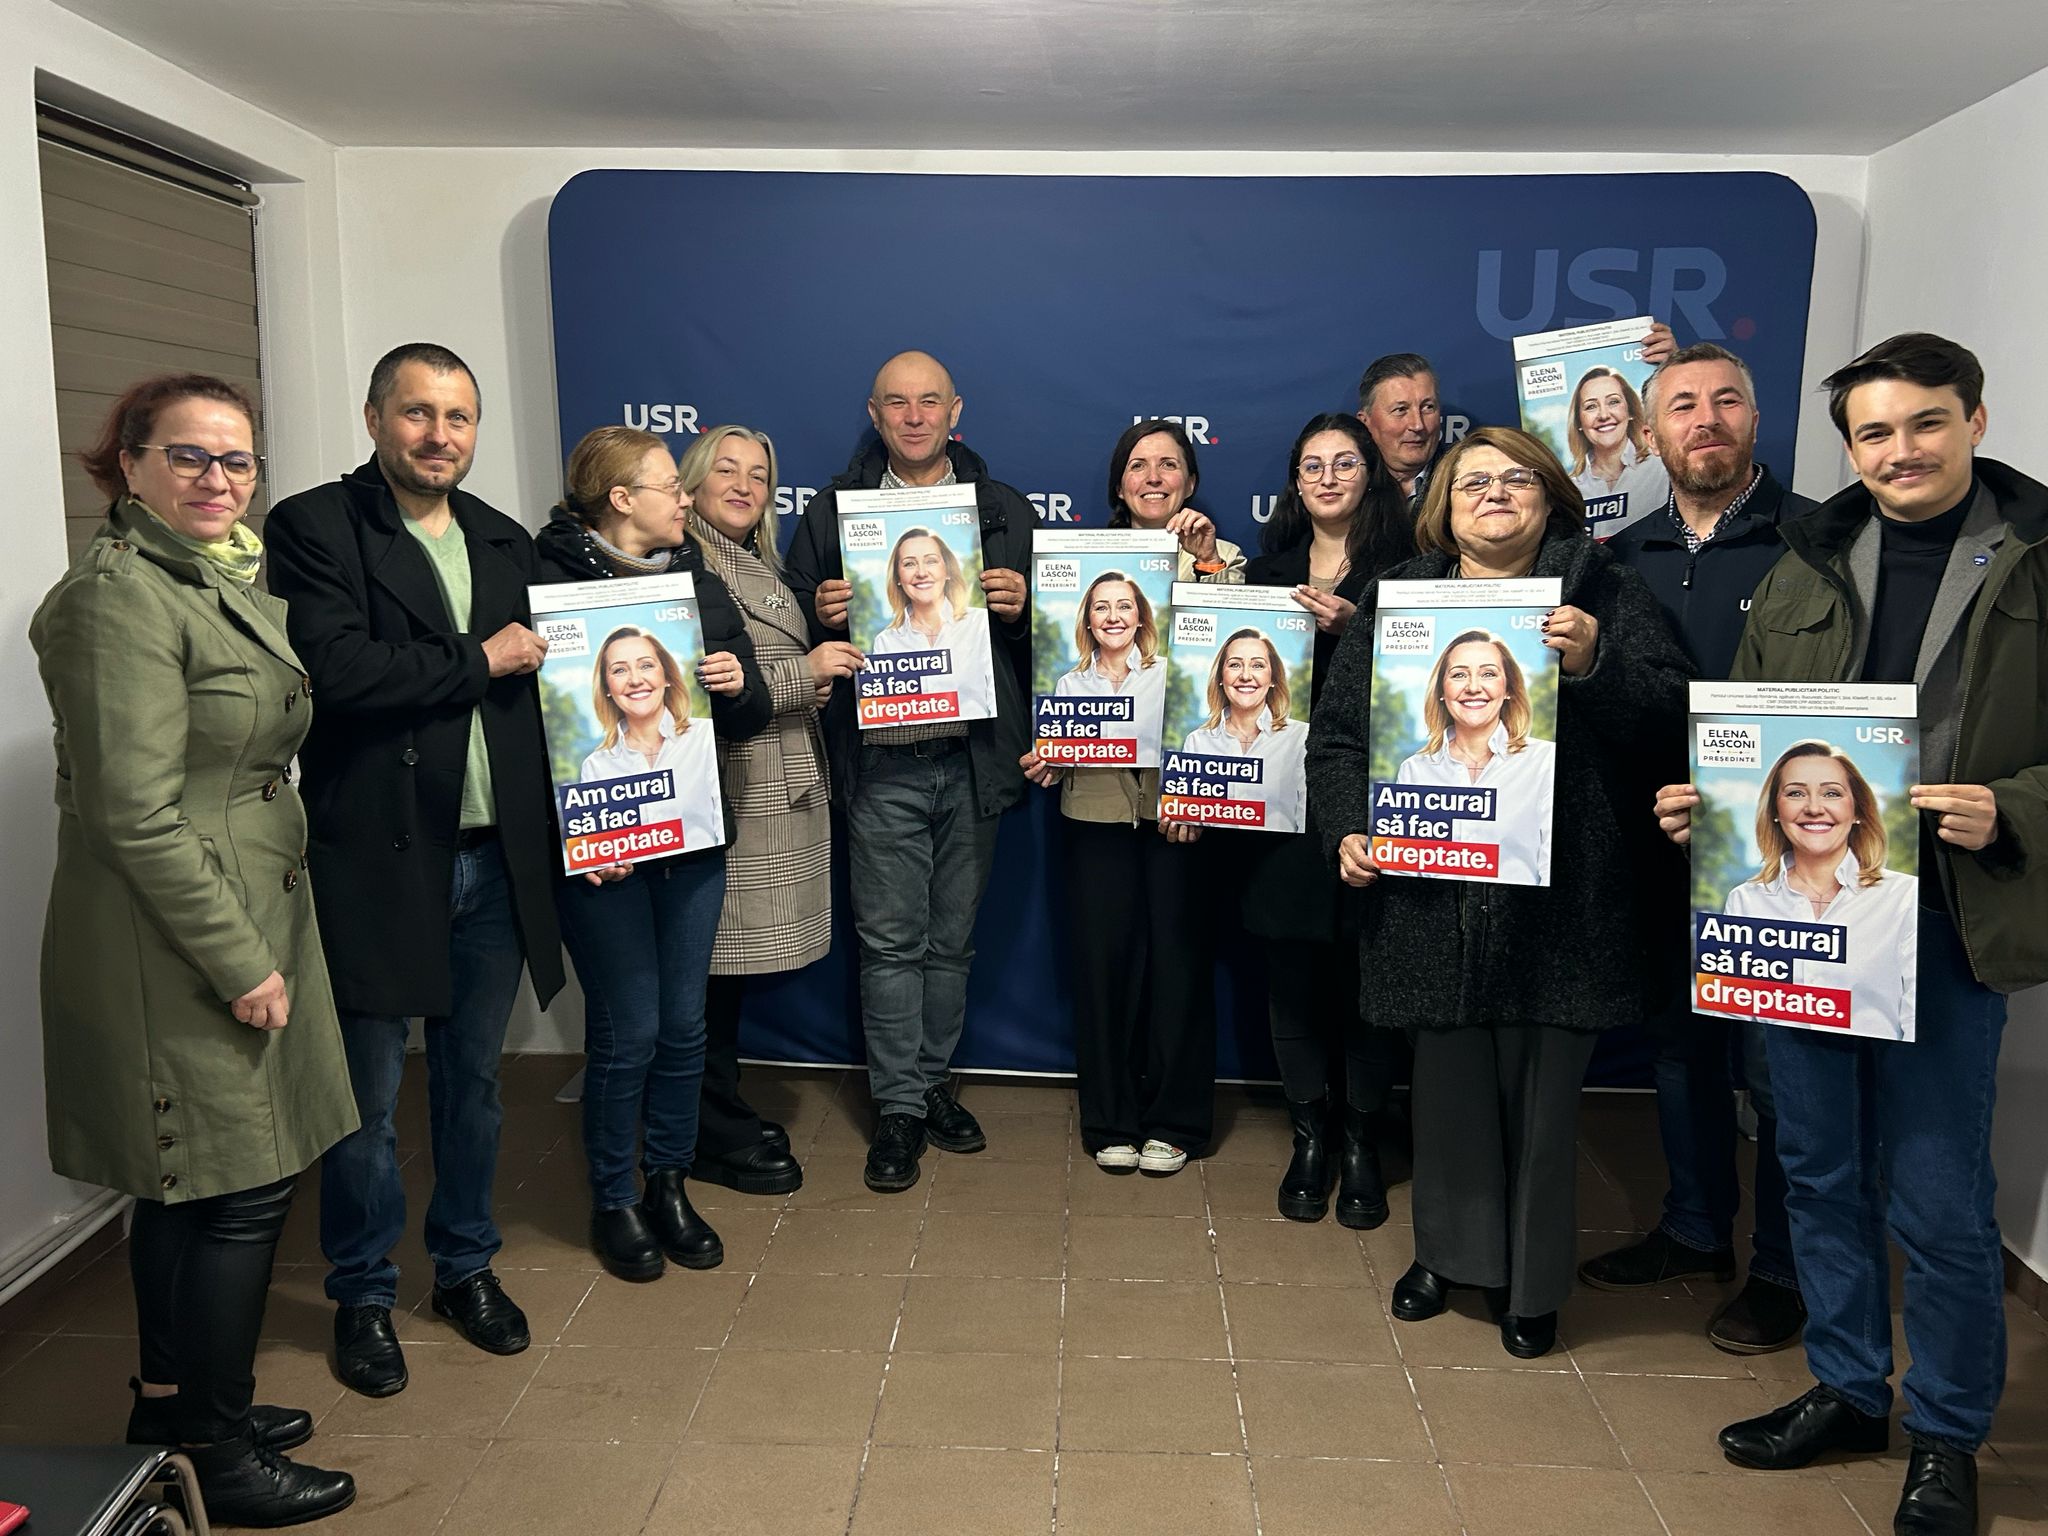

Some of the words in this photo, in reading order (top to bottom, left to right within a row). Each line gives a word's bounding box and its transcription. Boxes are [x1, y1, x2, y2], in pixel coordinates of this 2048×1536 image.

[1623, 348, 1646, 362] US
[1527, 374, 1562, 385] LASCONI
[1530, 367, 1557, 377] ELENA
[1585, 495, 1624, 518] uraj
[547, 624, 577, 633] ELENA
[1178, 624, 1213, 632] LASCONI
[1183, 617, 1209, 625] ELENA
[1386, 630, 1430, 638] LASCONI
[896, 652, 949, 672] curaj
[862, 679, 885, 698] să
[887, 676, 919, 694] fac
[864, 698, 956, 719] dreptate.
[1039, 700, 1074, 716] Am
[1078, 698, 1131, 720] curaj
[1039, 719, 1063, 737] să
[1065, 720, 1098, 737] fac
[1709, 729, 1749, 738] ELENA
[1855, 726, 1911, 745] USR.
[1039, 742, 1133, 762] dreptate.
[1703, 739, 1755, 749] LASCONI
[1166, 755, 1200, 774] Am
[1204, 759, 1259, 780] curaj
[565, 785, 609, 809] Am
[611, 773, 670, 806] curaj
[1165, 778, 1187, 796] să
[1191, 780, 1225, 797] fac
[1165, 799, 1261, 822] dreptate.
[1377, 787, 1421, 810] Am
[1424, 790, 1491, 818] curaj
[568, 815, 597, 837] să
[599, 808, 637, 831] fac
[1376, 815, 1403, 836] să
[1408, 817, 1449, 839] fac
[572, 828, 680, 862] dreptate.
[1376, 841, 1494, 870] dreptate.
[1700, 917, 1752, 945] Am
[1758, 925, 1840, 959] curaj
[1700, 949, 1732, 974] să
[1739, 951, 1789, 980] fac
[1700, 979, 1844, 1018] dreptate.
